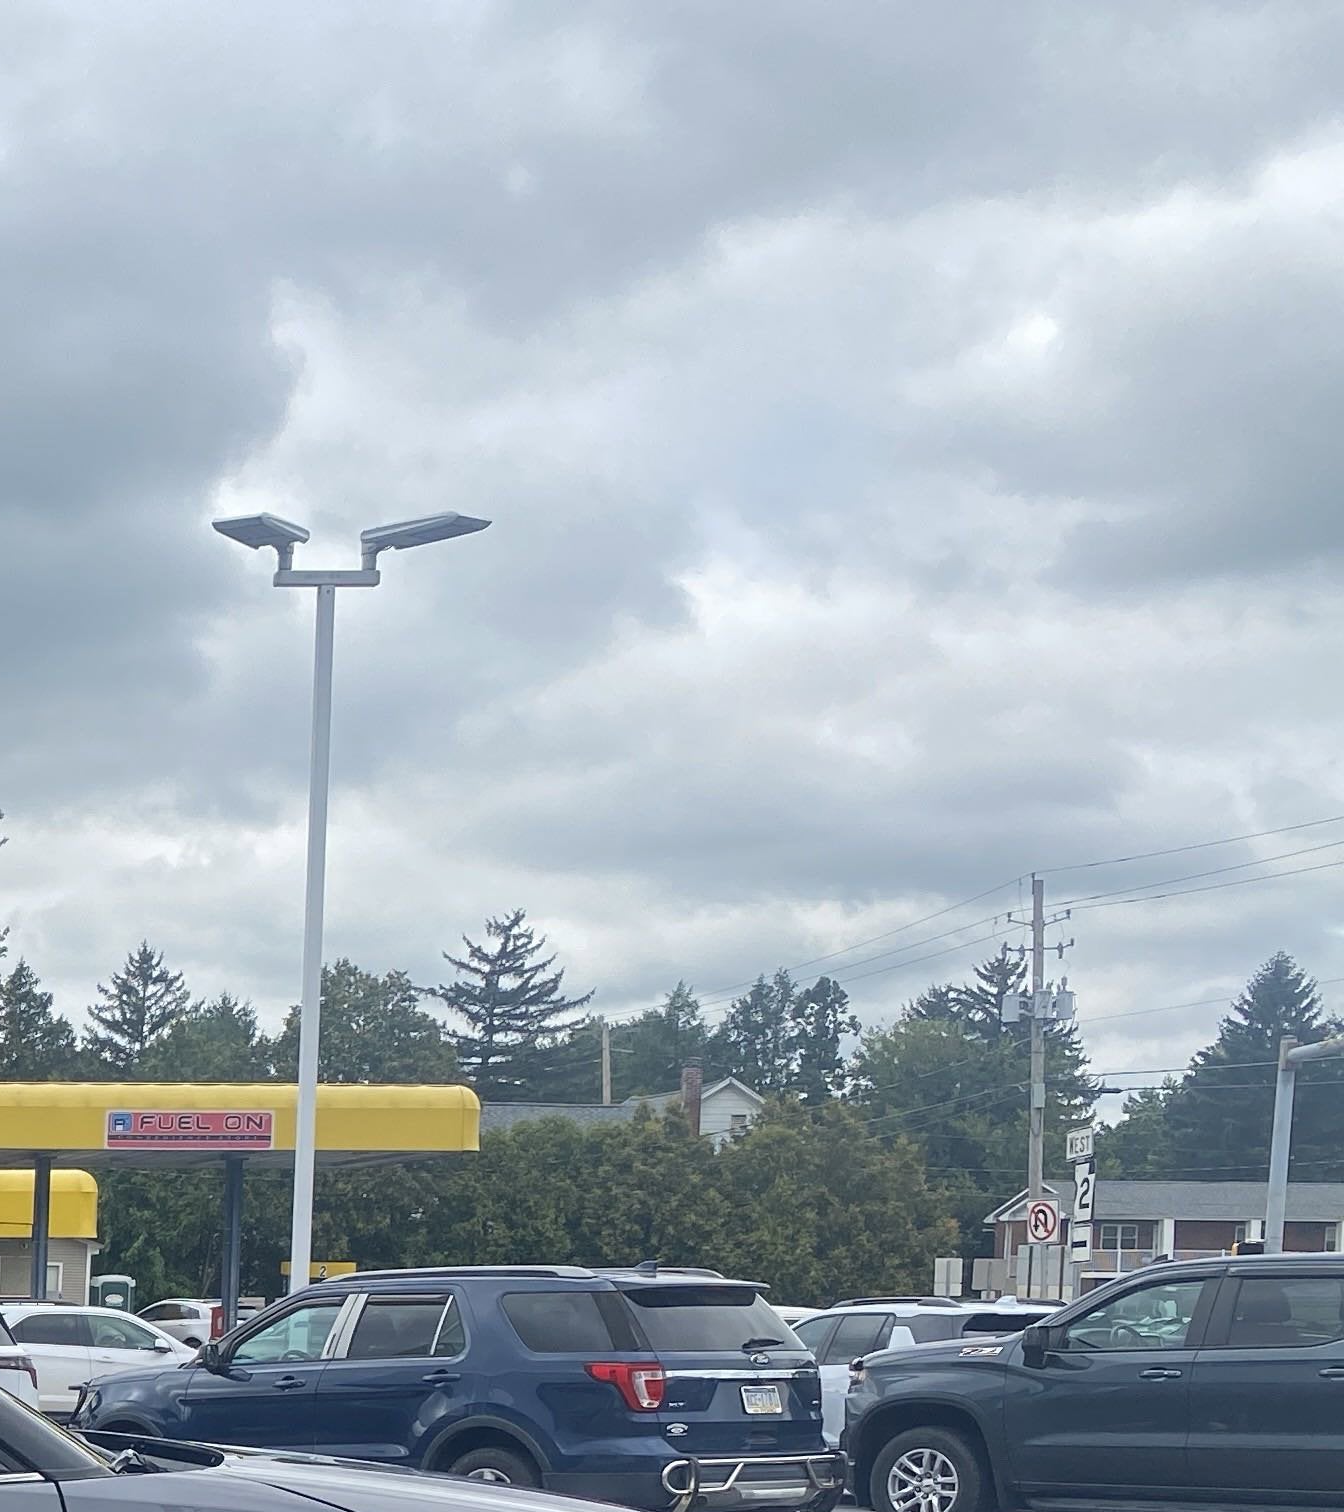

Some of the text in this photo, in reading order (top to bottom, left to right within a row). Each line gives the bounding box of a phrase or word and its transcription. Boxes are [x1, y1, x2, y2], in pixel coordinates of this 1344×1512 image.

[139, 1115, 265, 1131] FUEL ON
[1069, 1135, 1090, 1155] WEST
[1078, 1177, 1090, 1210] 2
[319, 1265, 328, 1277] 2
